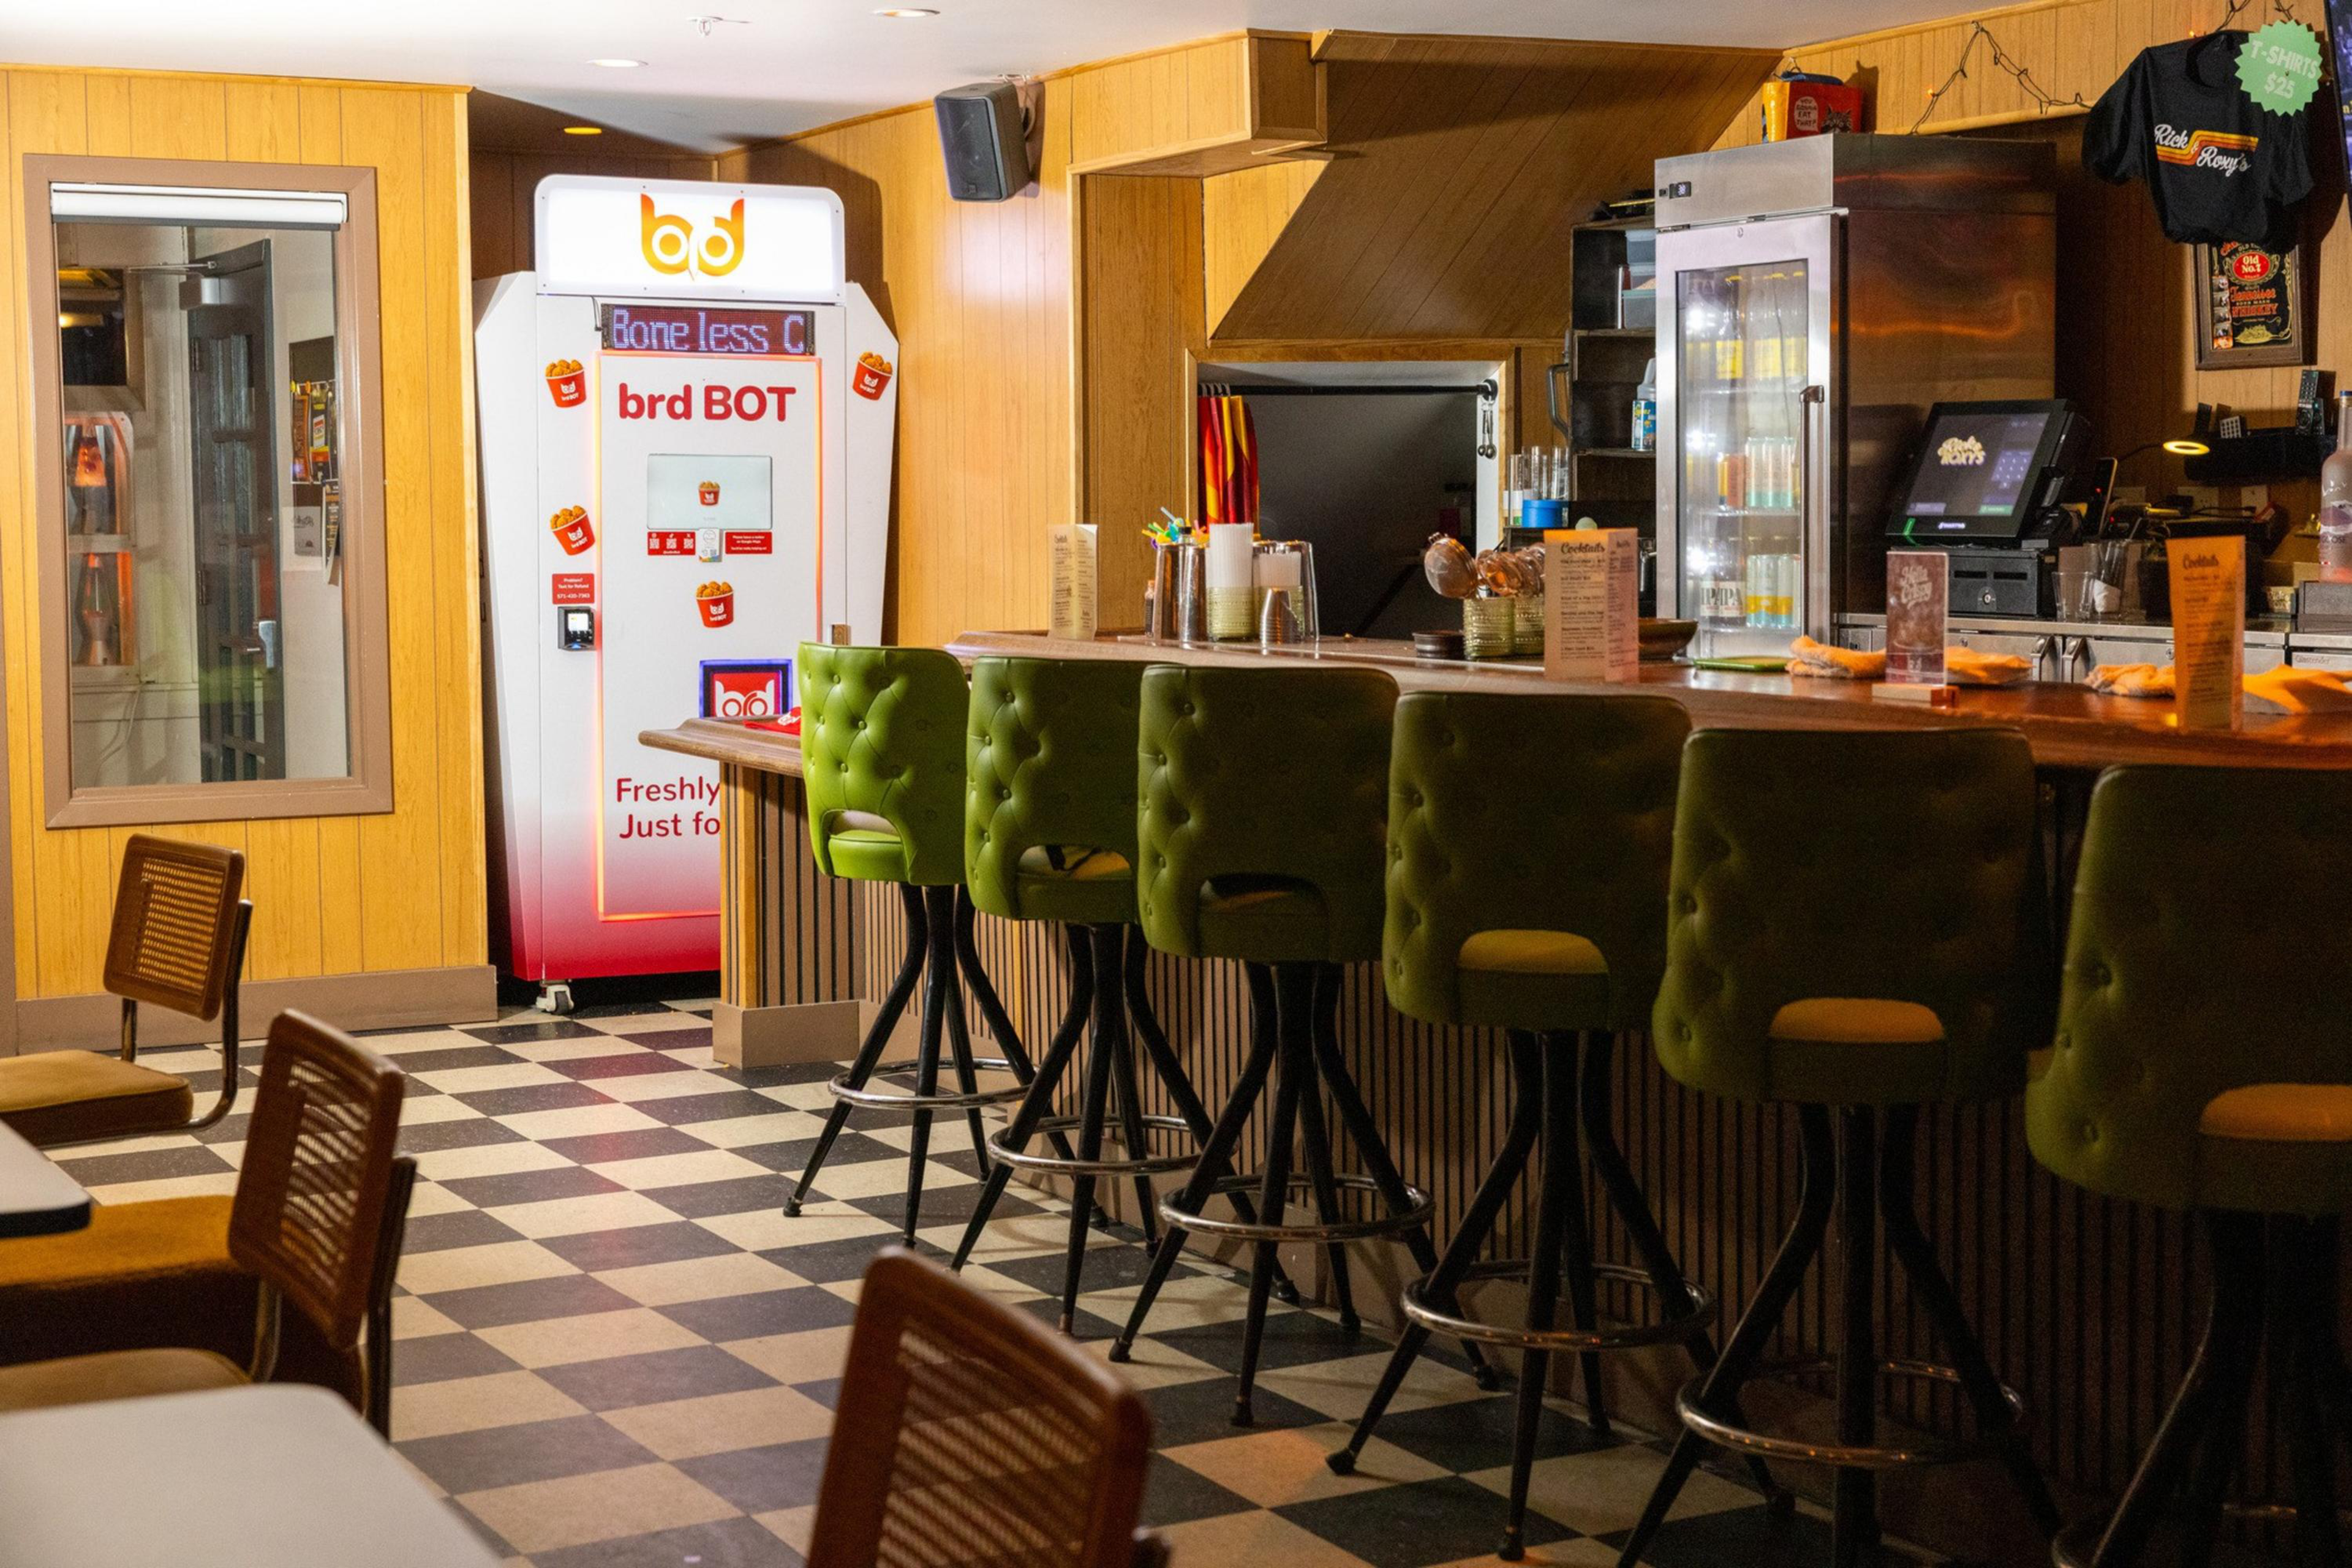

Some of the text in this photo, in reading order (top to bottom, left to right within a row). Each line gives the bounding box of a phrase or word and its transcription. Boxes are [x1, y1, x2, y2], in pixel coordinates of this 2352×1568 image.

[2252, 40, 2318, 78] T-SHIRTS
[2266, 74, 2294, 99] $25
[2155, 123, 2188, 150] Rick
[2197, 146, 2250, 178] Roxy's
[2242, 255, 2259, 264] Old
[2232, 303, 2278, 317] WHISKEY
[784, 312, 804, 354] C
[619, 383, 796, 422] brd BOT
[1561, 542, 1605, 555] Cocktails
[616, 776, 720, 805] Freshly
[619, 812, 682, 839] Just
